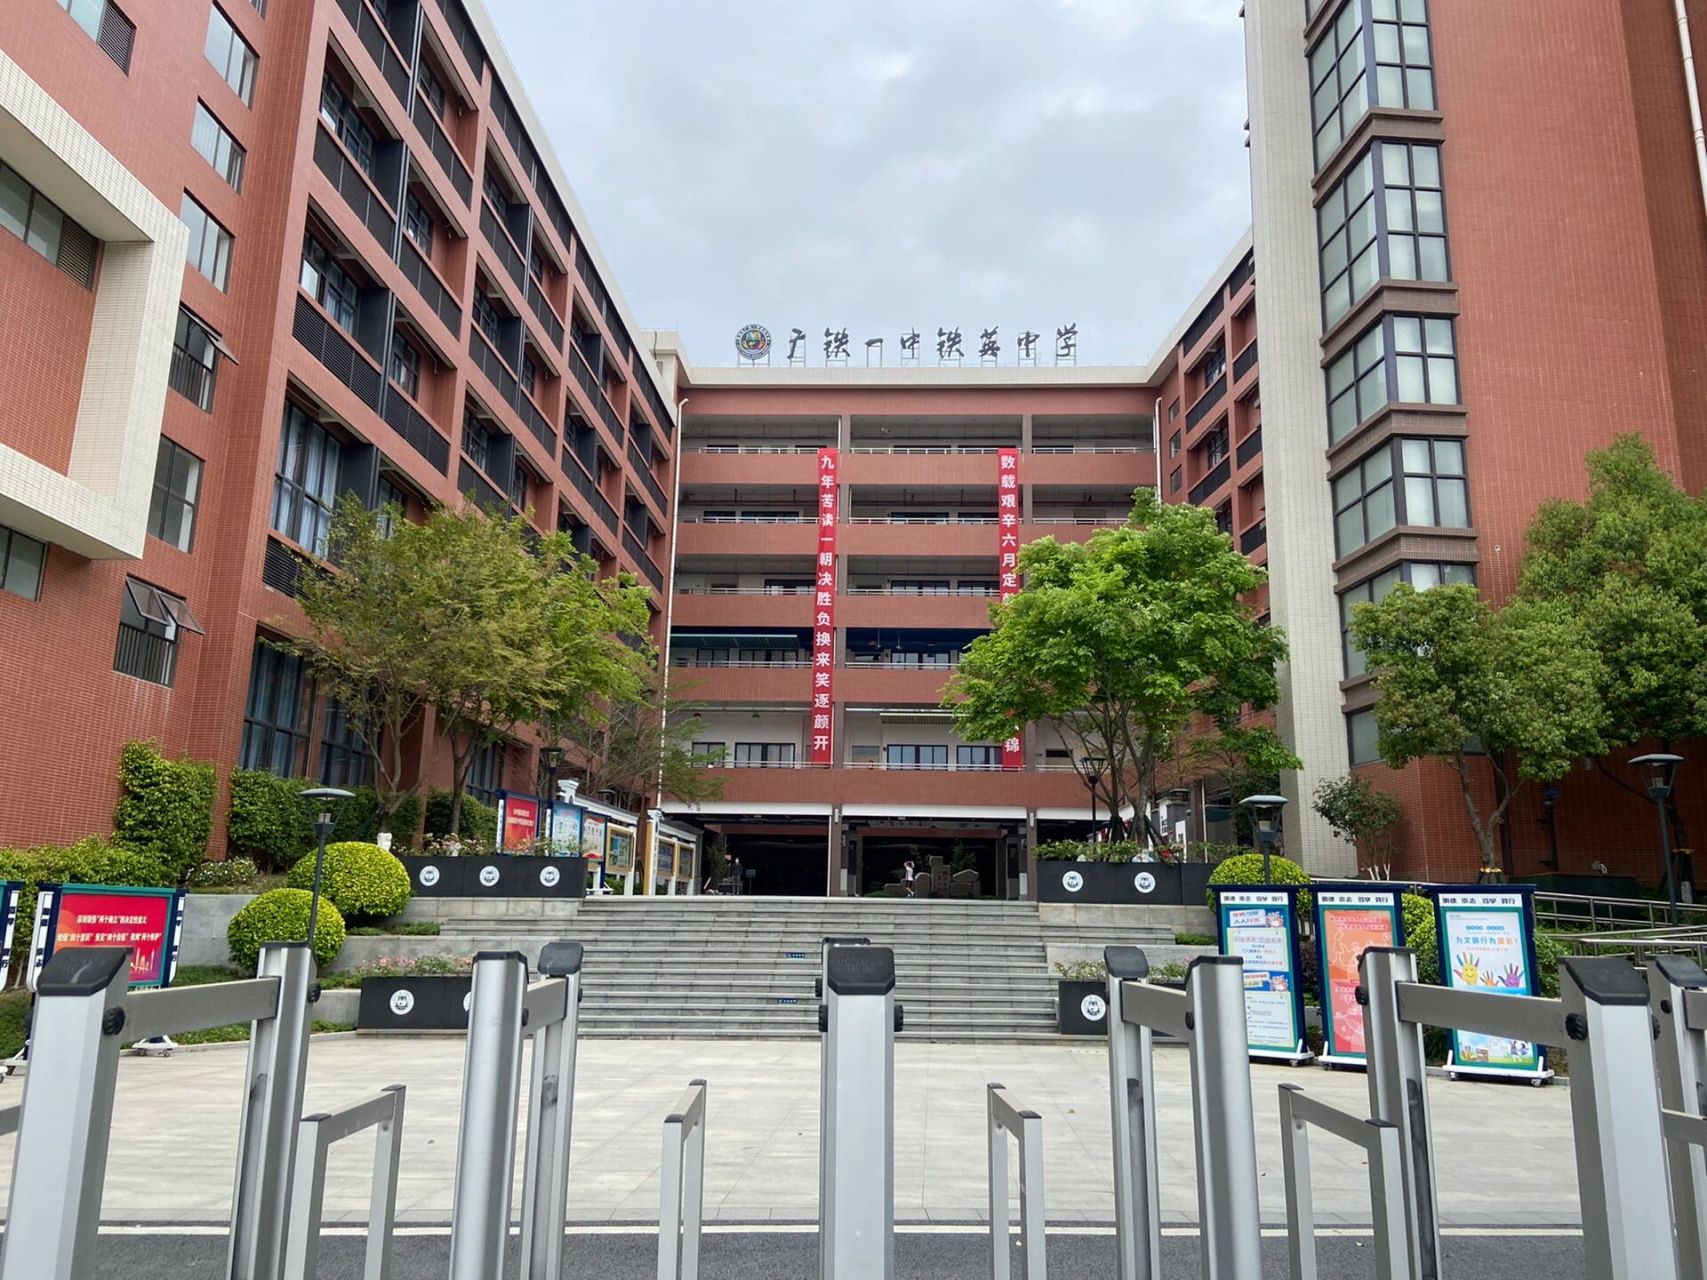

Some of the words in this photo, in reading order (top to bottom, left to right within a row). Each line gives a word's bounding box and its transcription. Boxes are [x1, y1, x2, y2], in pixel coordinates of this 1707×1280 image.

[786, 321, 1079, 360] 广铁一中铁英中学
[813, 454, 835, 751] 九年苦读一朝决胜负换来笑逐颜开
